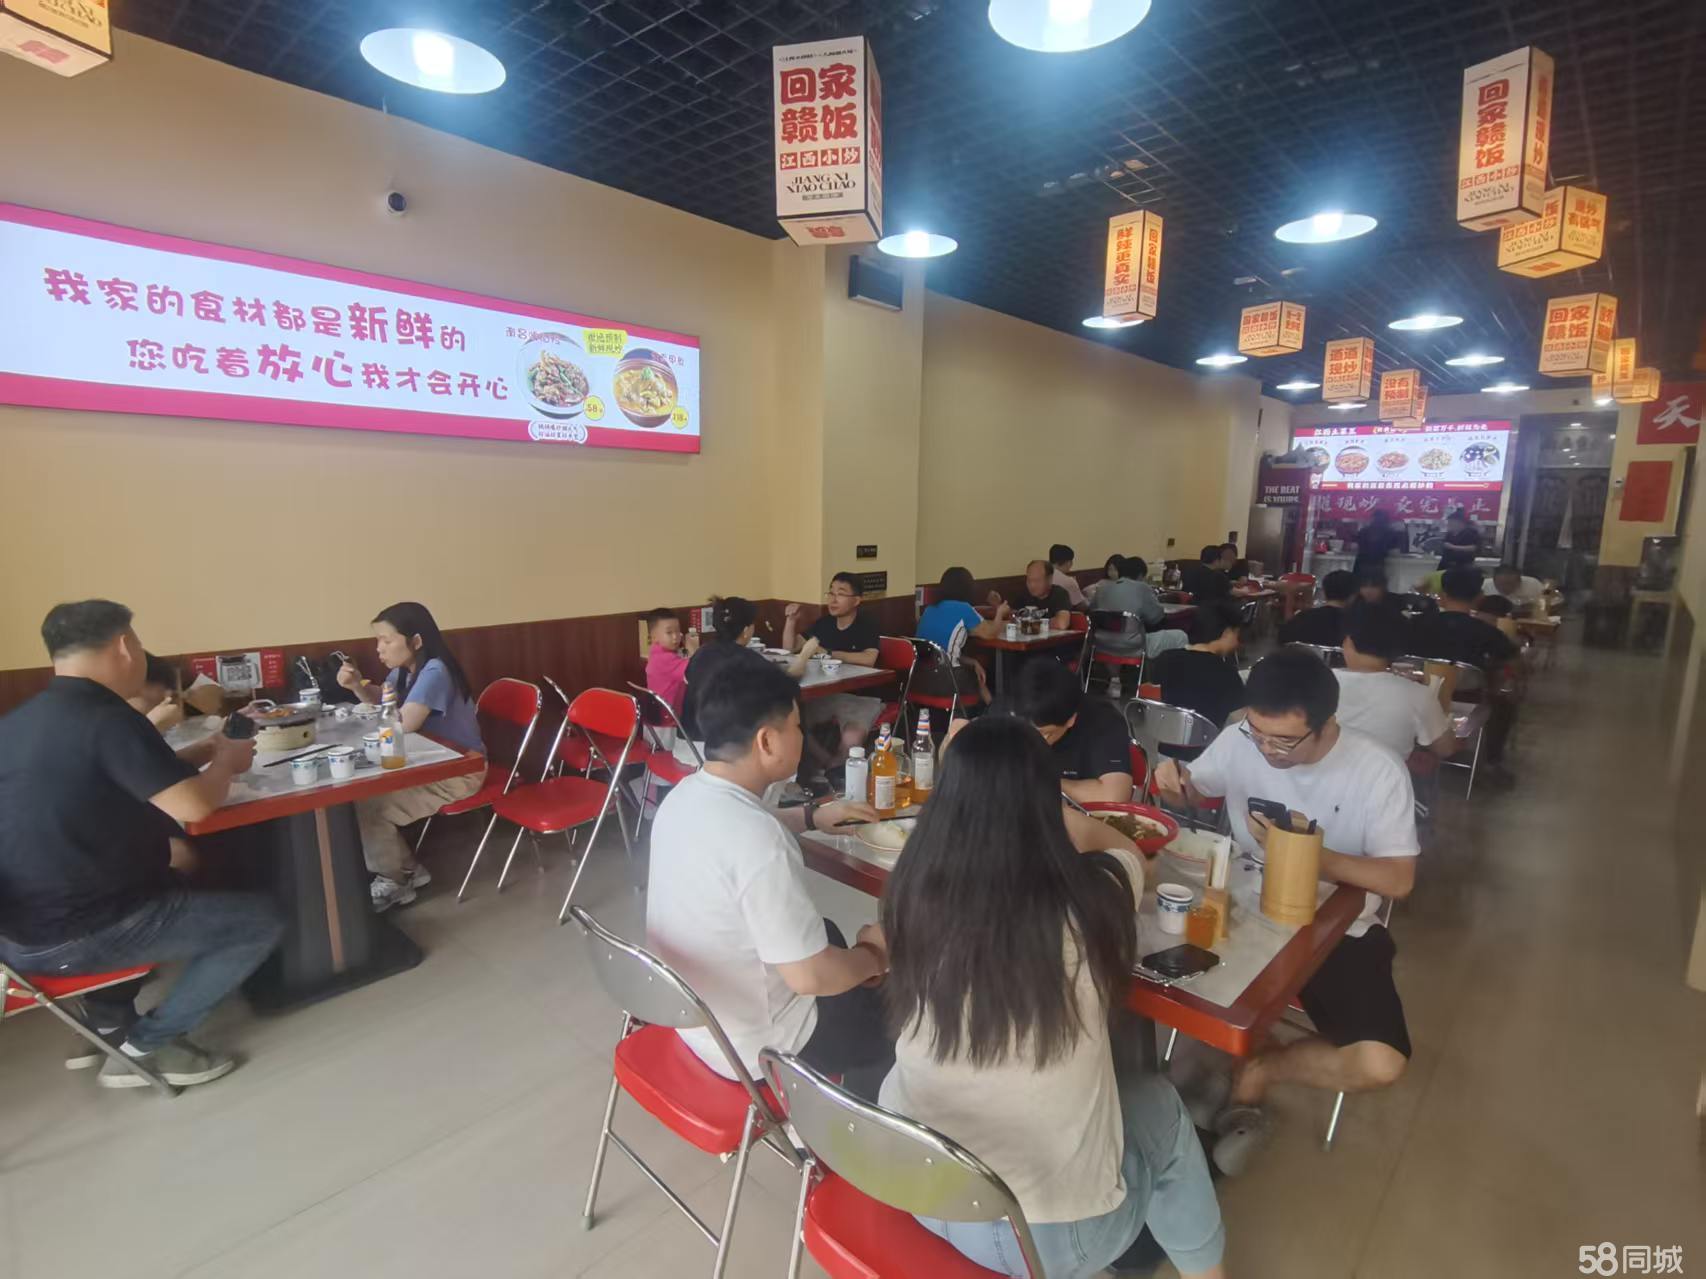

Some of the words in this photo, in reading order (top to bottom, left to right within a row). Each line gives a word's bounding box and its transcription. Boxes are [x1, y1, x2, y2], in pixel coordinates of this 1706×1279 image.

[780, 62, 857, 104] 回家
[781, 102, 858, 144] 赣饭
[1475, 78, 1510, 169] 回家赣饭
[781, 148, 860, 169] 江西小炒
[787, 183, 817, 193] XIAO
[819, 181, 856, 191] CHAO
[792, 174, 830, 185] JIANG
[835, 172, 849, 181] XI
[43, 266, 467, 354] 我家的食材都是新鲜的
[1550, 305, 1590, 323] 回家
[1547, 322, 1588, 340] 赣饭
[126, 337, 508, 402] 您吃着放心我才会开心
[1652, 394, 1703, 430] 天
